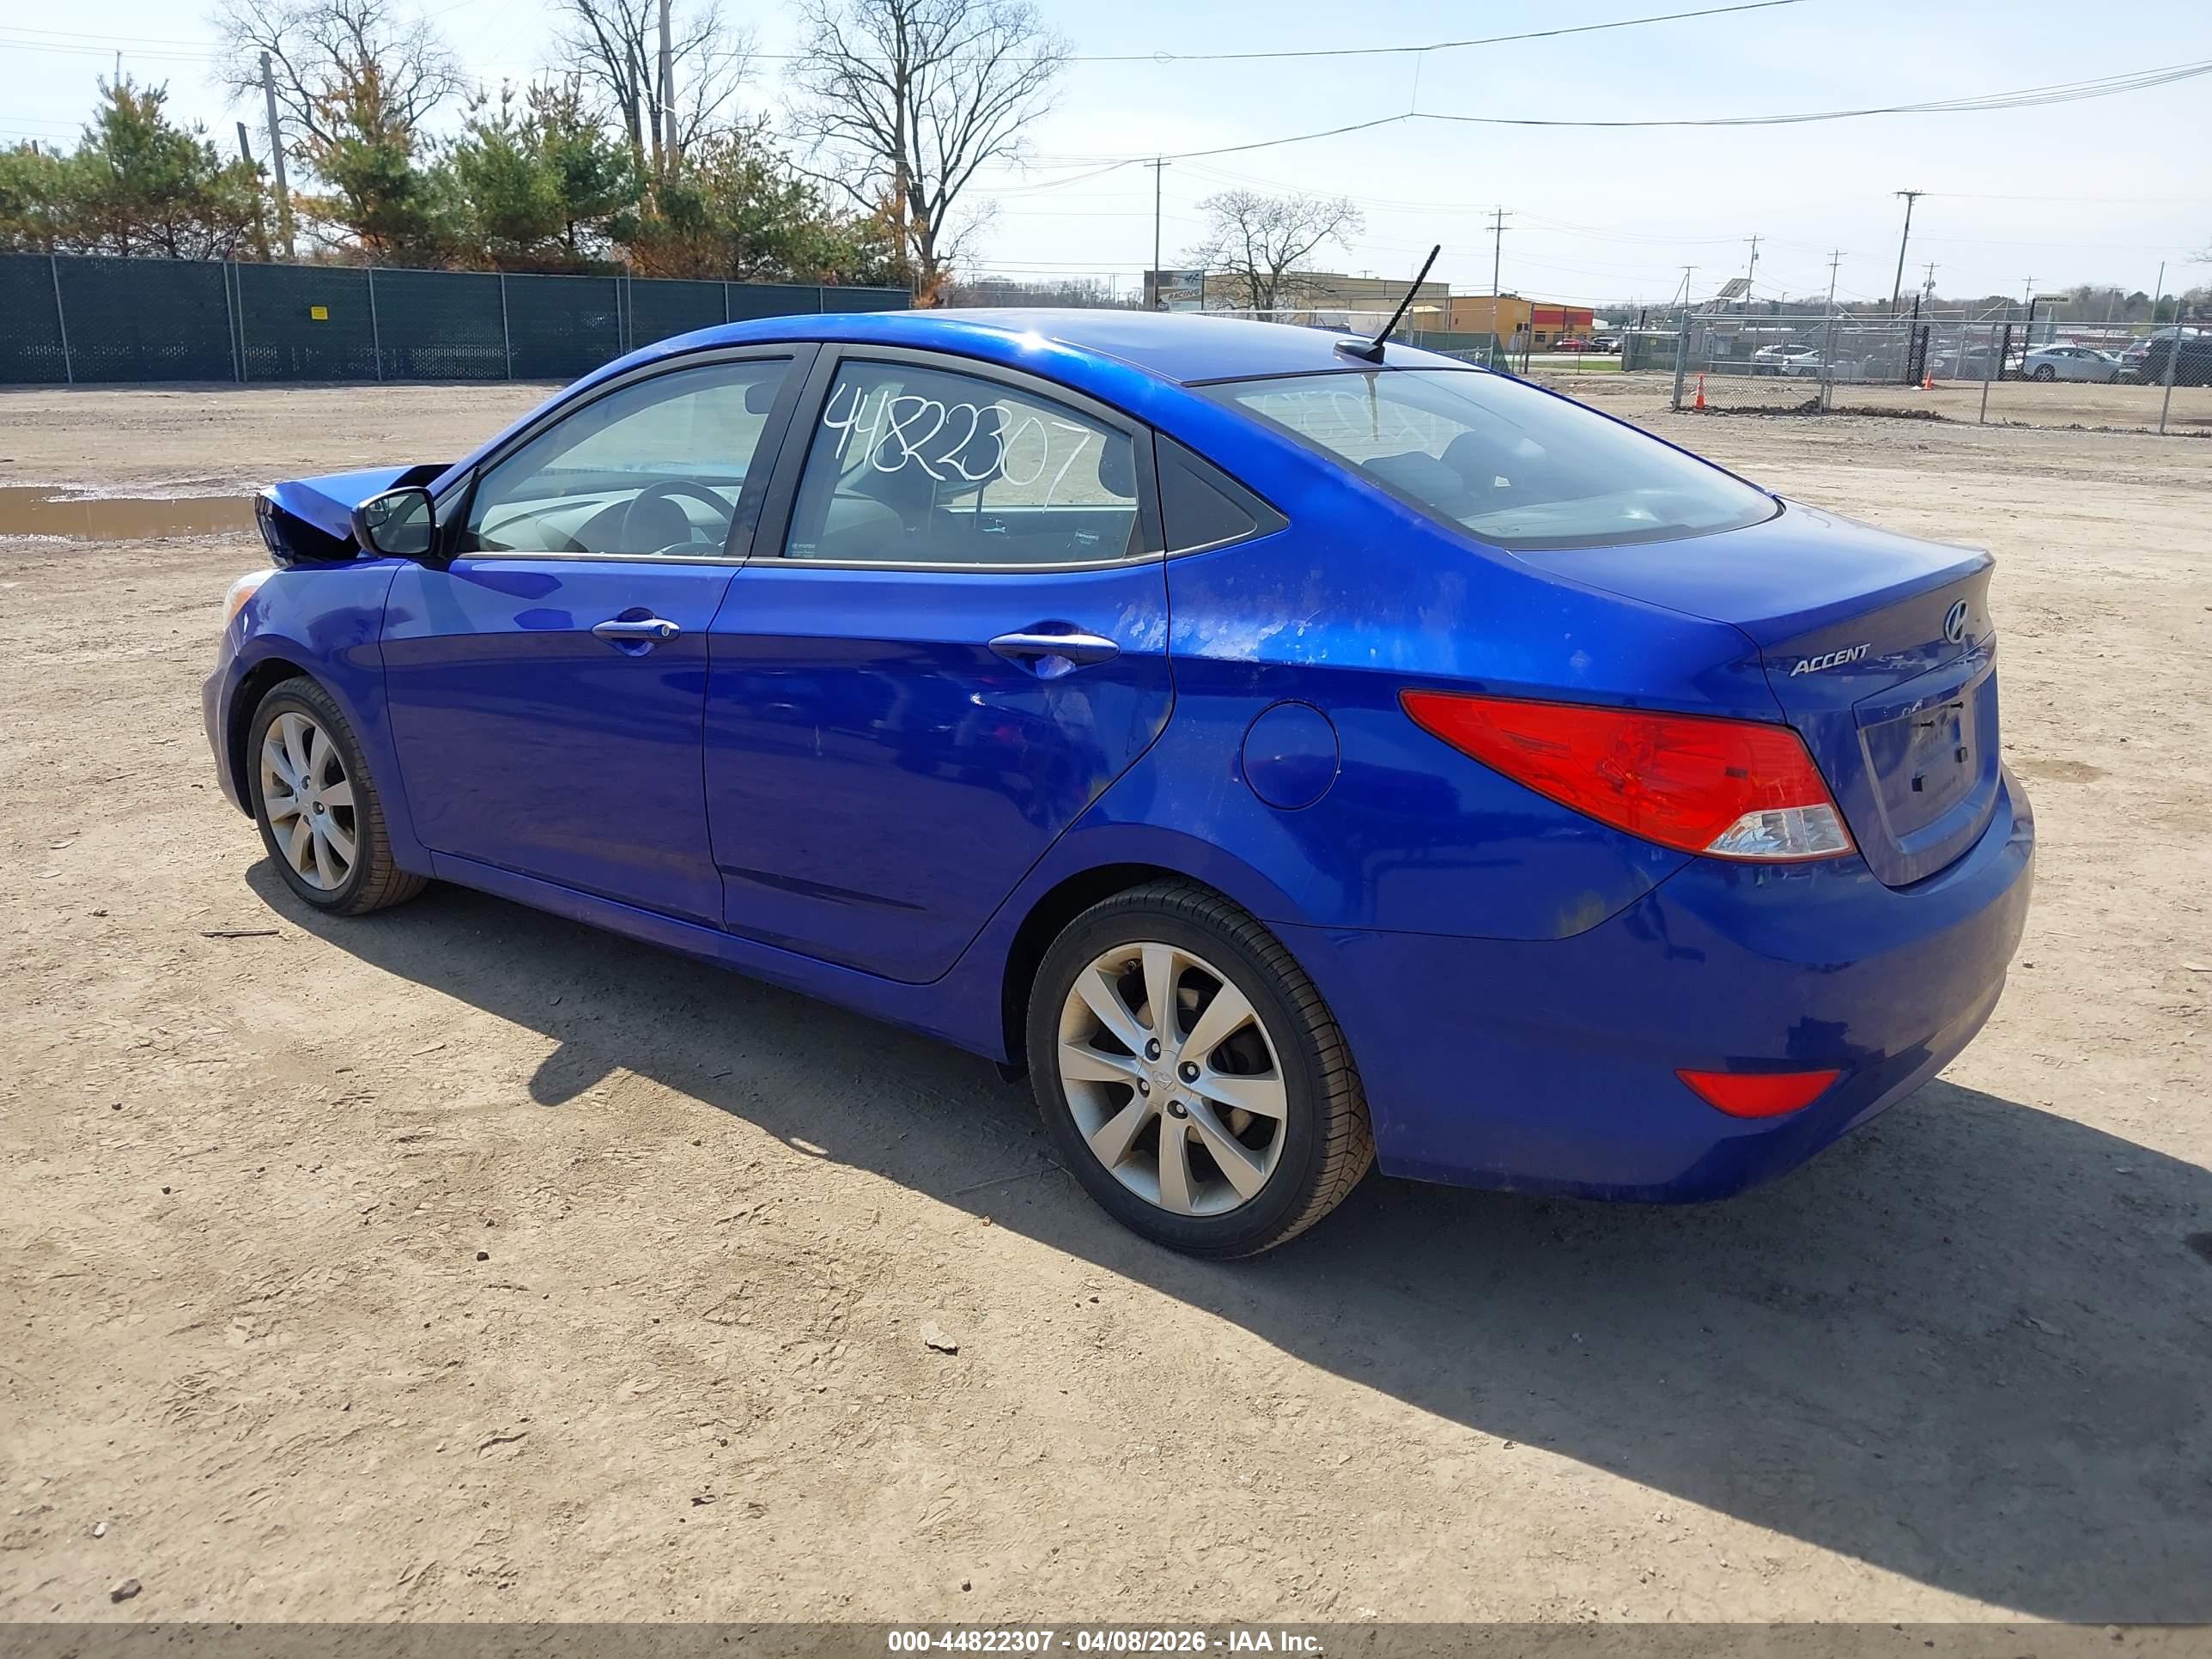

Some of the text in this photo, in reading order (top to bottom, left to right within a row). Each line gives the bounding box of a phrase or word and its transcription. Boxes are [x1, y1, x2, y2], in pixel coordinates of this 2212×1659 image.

[1168, 289, 1200, 301] RACING
[823, 383, 1091, 514] 44822307
[1789, 643, 1871, 677] ACCENT
